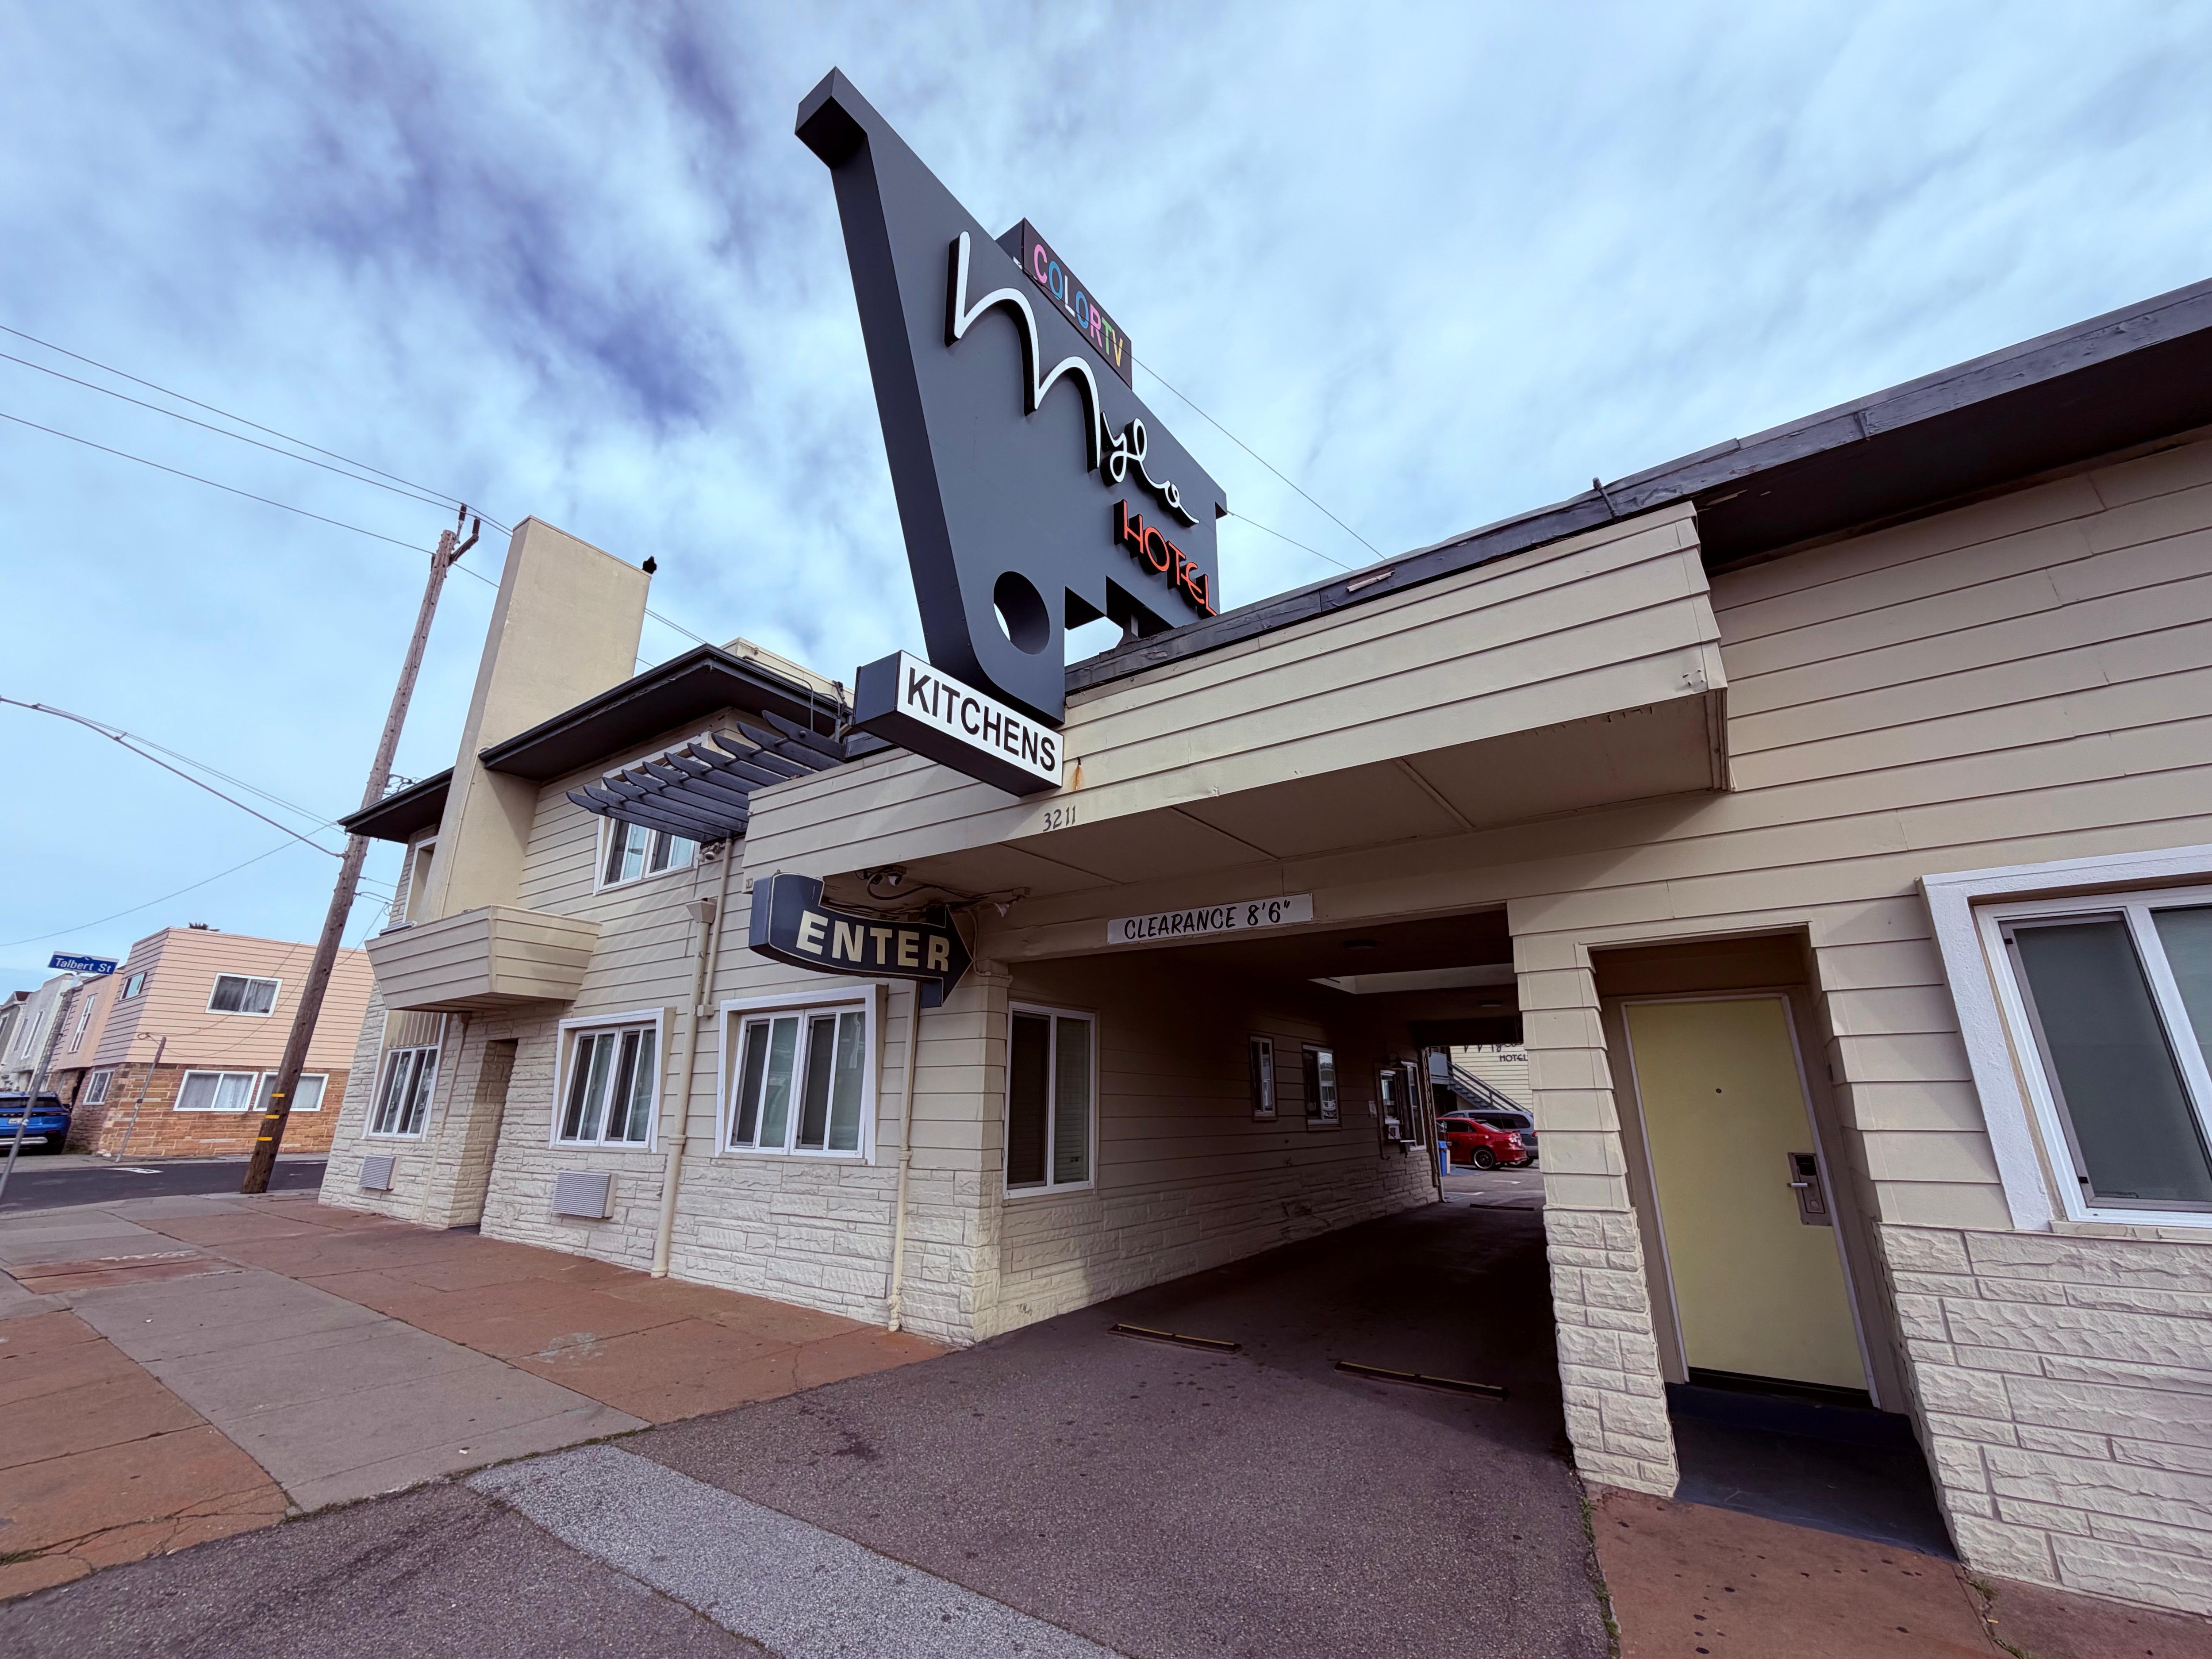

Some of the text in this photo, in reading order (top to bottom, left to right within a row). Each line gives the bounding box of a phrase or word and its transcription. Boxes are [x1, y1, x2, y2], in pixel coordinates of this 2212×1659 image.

[1123, 499, 1219, 616] HOTEL
[907, 666, 1056, 772] KITCHENS
[1042, 805, 1076, 832] 3211
[796, 910, 950, 972] ENTER
[1124, 906, 1237, 939] CLEARANCE
[56, 957, 111, 972] Talbert St
